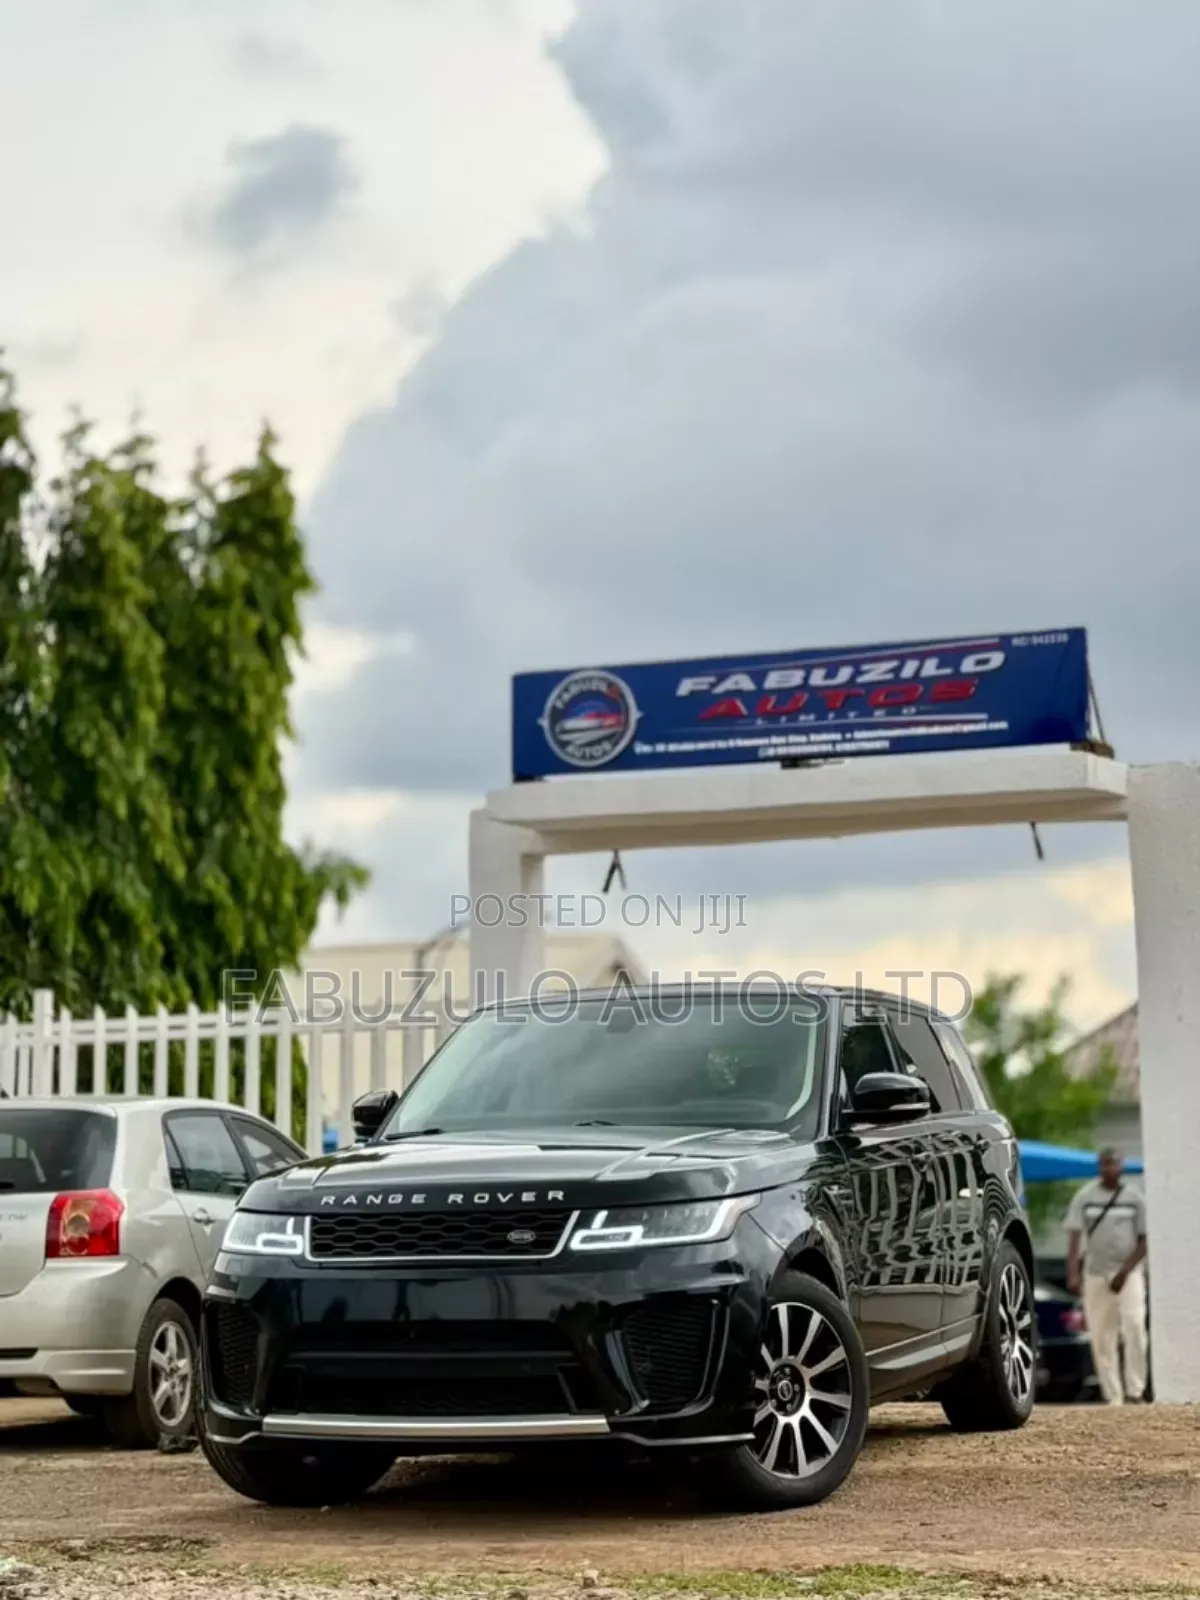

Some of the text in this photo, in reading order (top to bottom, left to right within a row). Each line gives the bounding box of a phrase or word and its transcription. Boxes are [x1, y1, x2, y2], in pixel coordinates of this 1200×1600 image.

[676, 651, 1005, 697] FABUZILO
[698, 677, 979, 720] AUTOS
[320, 1190, 565, 1205] RANGE ROVER
